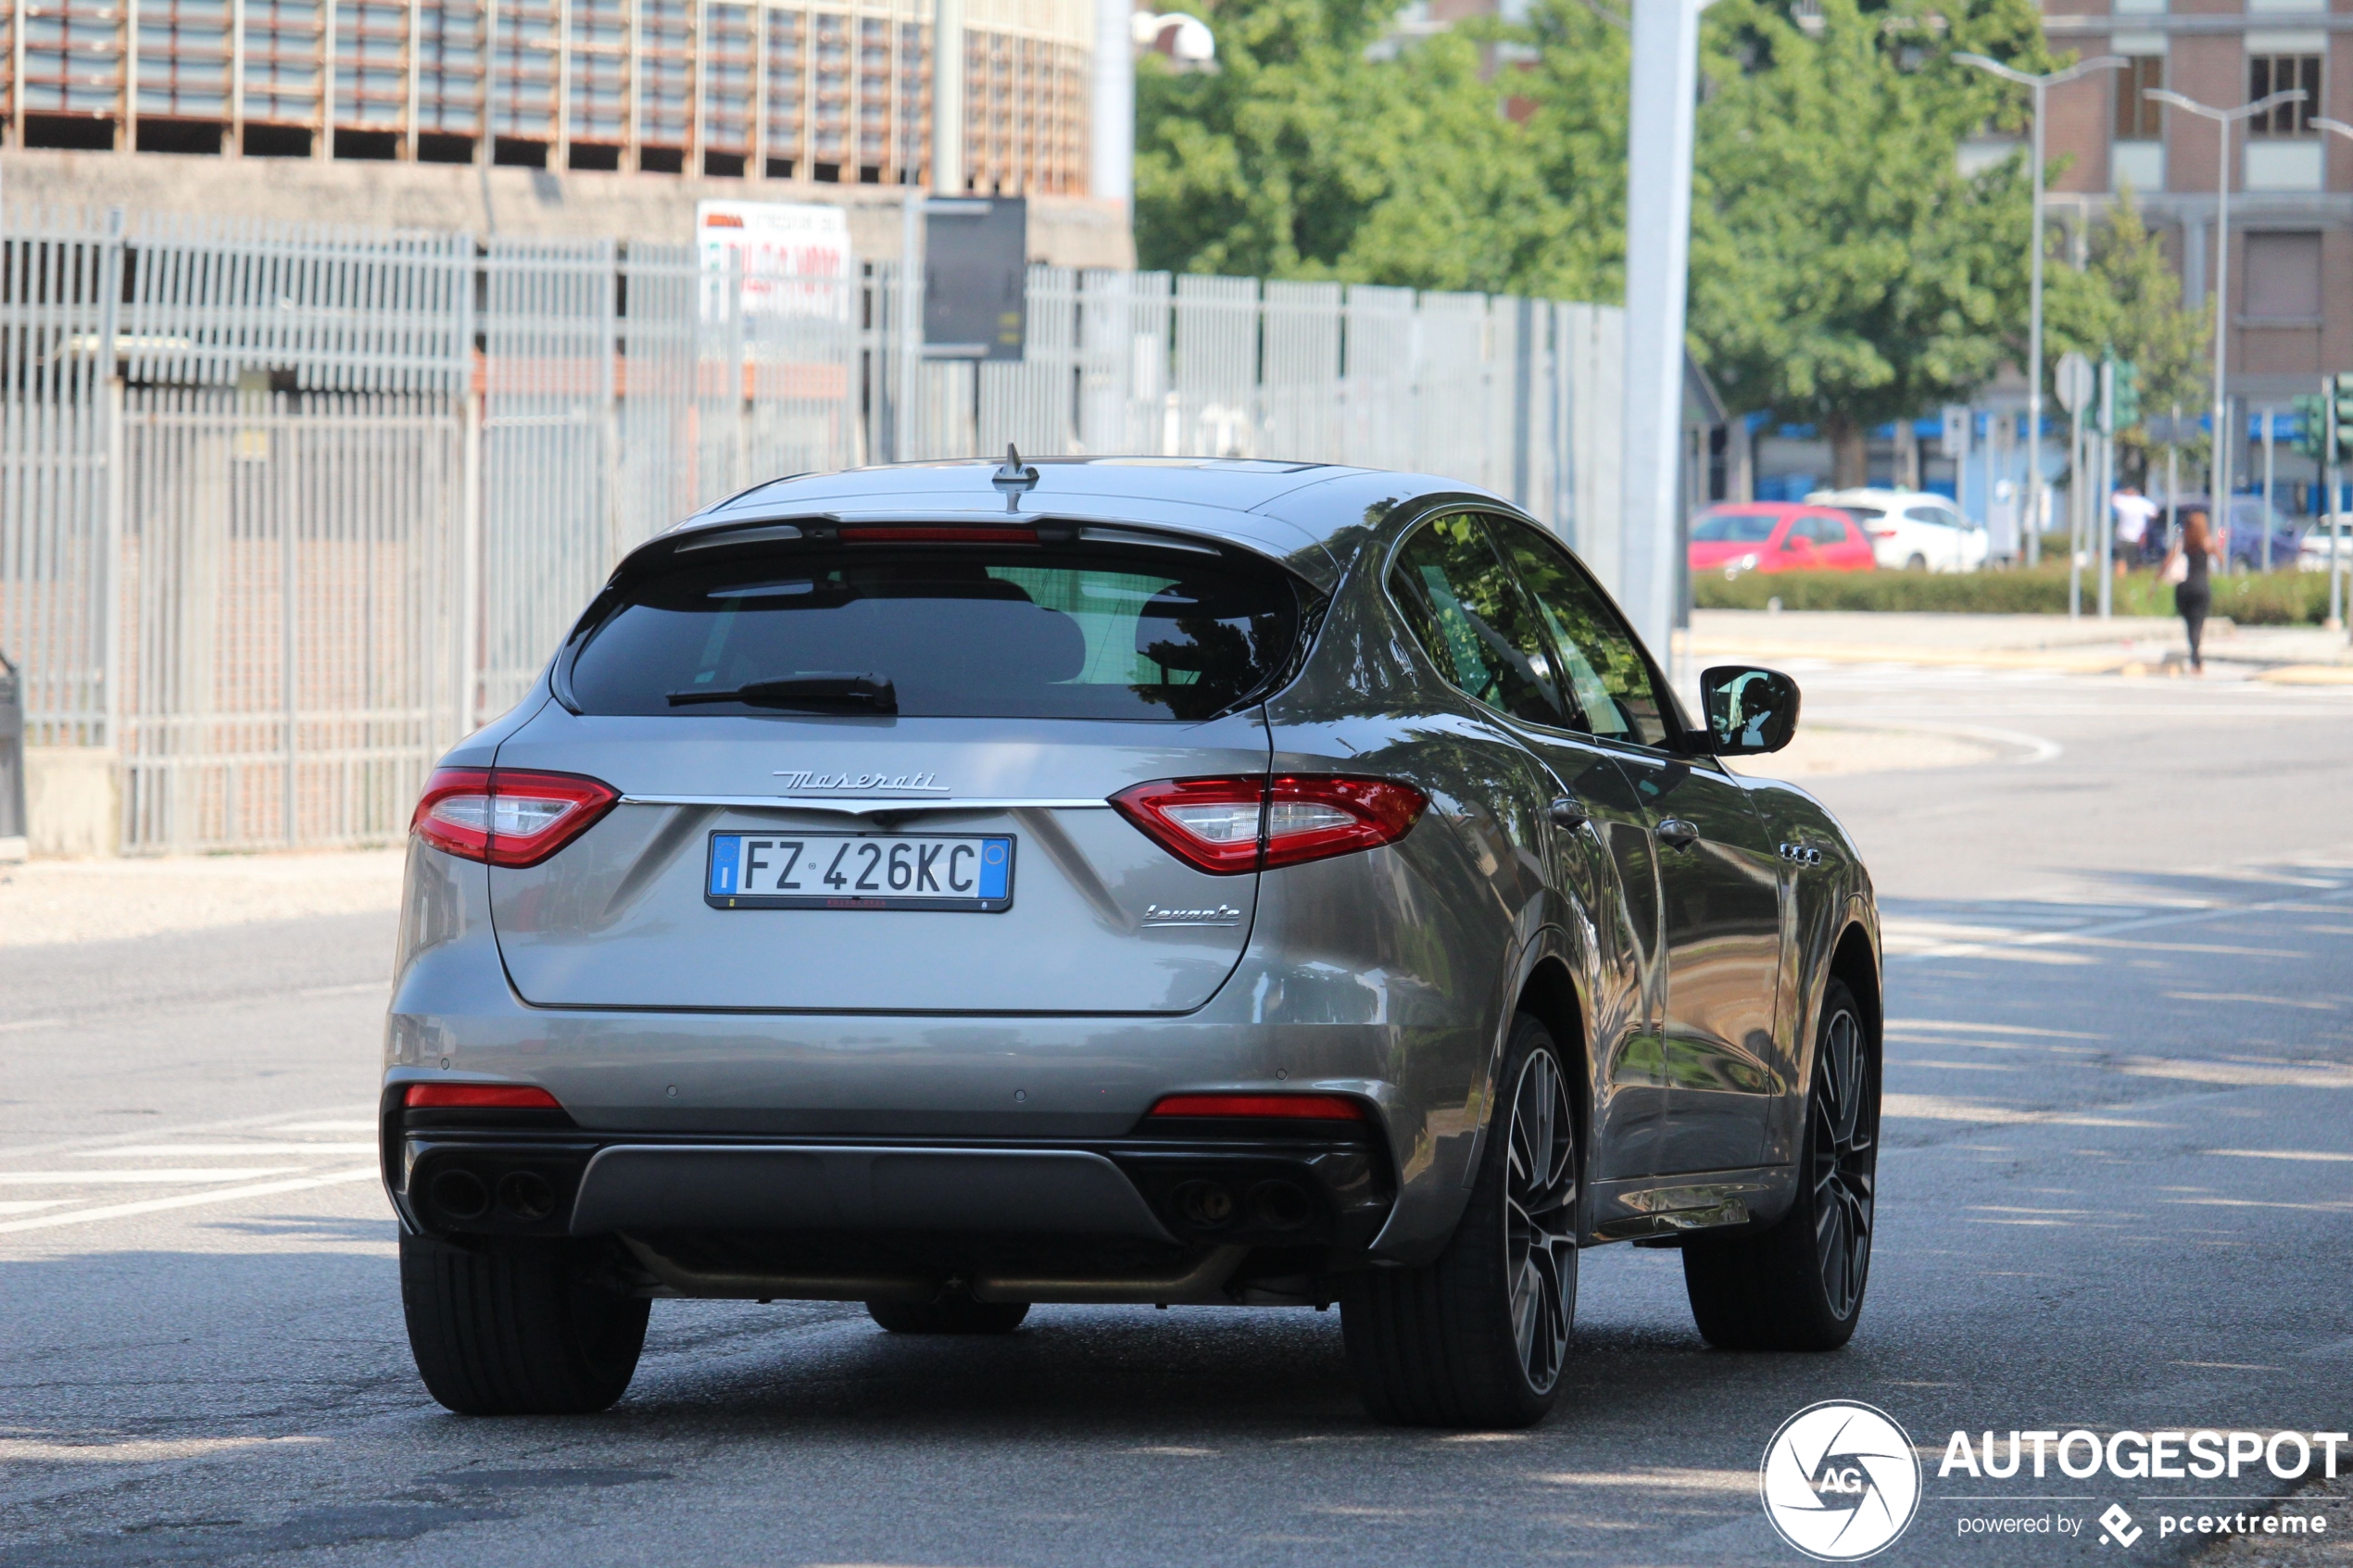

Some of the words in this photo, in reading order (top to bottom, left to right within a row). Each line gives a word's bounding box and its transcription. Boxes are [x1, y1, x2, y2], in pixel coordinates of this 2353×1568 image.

[772, 771, 950, 792] Maserati
[745, 841, 804, 889] FZ
[823, 842, 975, 892] 426KC
[1142, 904, 1240, 921] Levante
